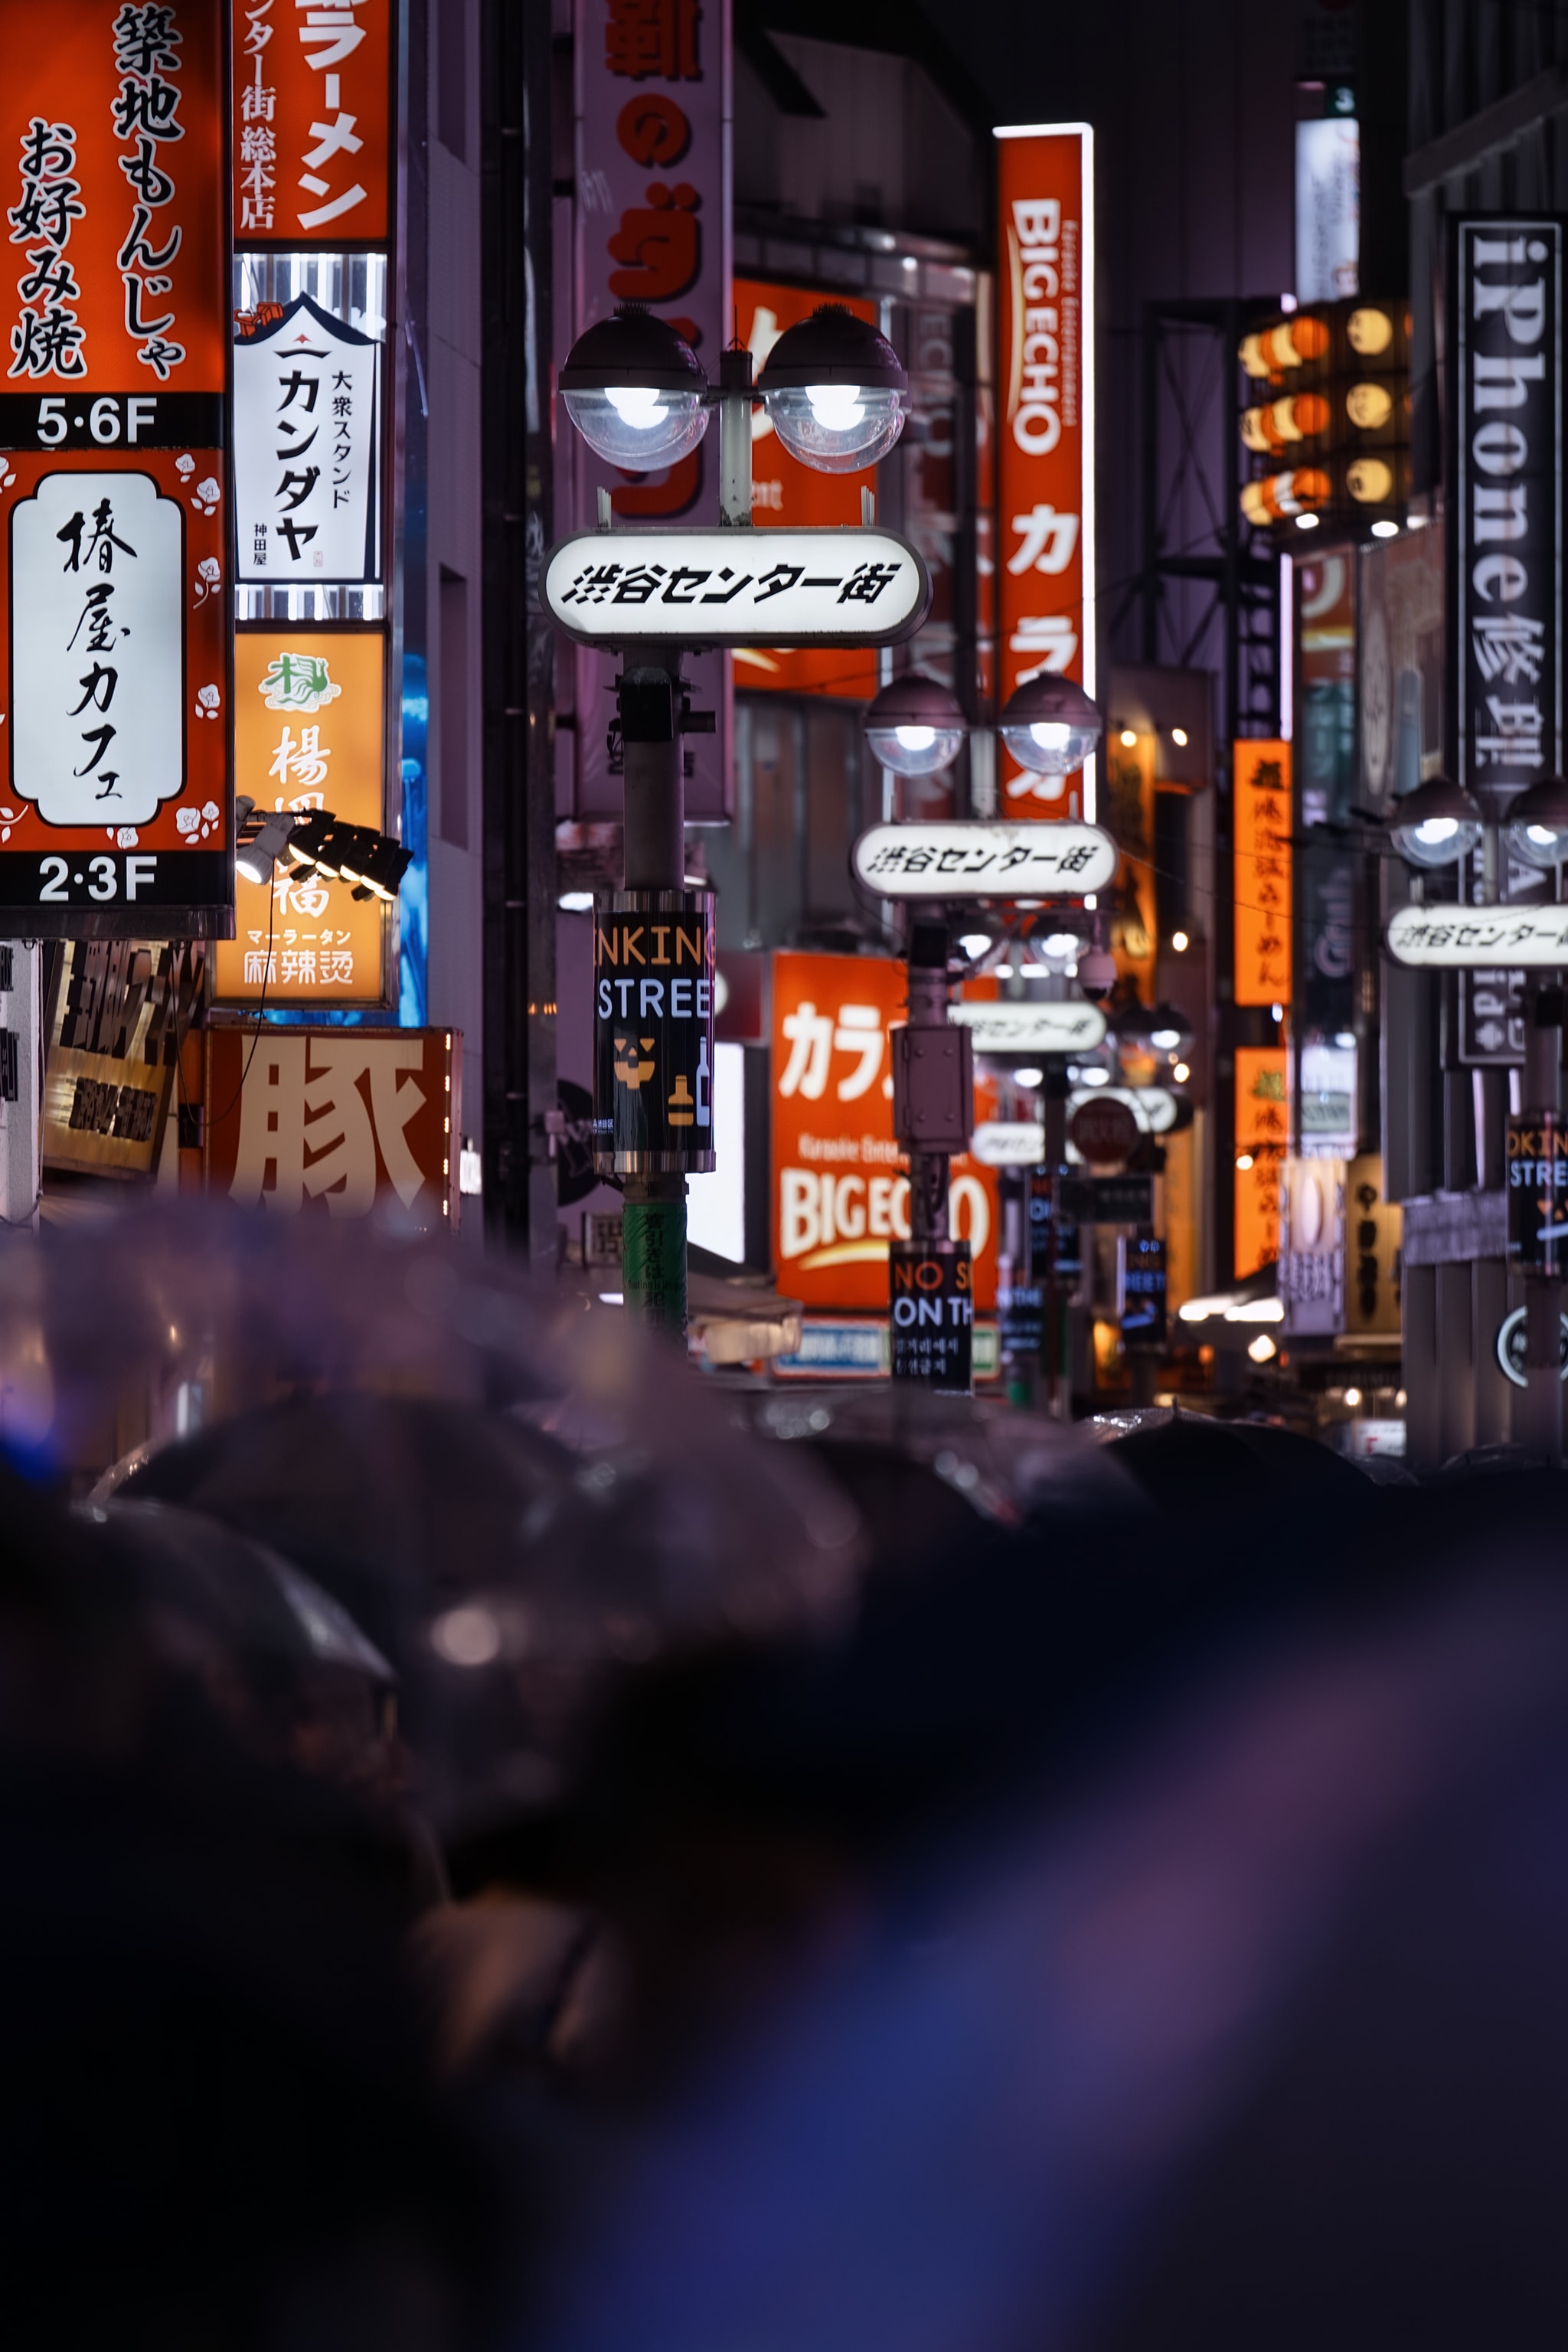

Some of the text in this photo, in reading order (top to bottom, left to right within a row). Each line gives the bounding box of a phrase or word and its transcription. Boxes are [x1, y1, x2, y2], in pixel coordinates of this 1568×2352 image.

[111, 2, 186, 381] 築地もんじゃ
[8, 117, 87, 380] お好み焼
[1011, 198, 1062, 456] BIG ECHO
[274, 369, 321, 561] カンダヤ
[332, 370, 353, 509] 大衆スタンド
[253, 523, 266, 565] 神田屋
[561, 562, 902, 604] 渋谷センター街
[56, 498, 138, 801] 椿屋カフェ
[866, 846, 1099, 874] 渋谷センター街
[247, 929, 351, 946] マーラータン
[778, 1001, 894, 1102] カラ
[228, 1034, 426, 1220] 豚
[780, 1167, 867, 1258] BIG
[894, 1297, 942, 1327] ON
[895, 1262, 943, 1290] NO
